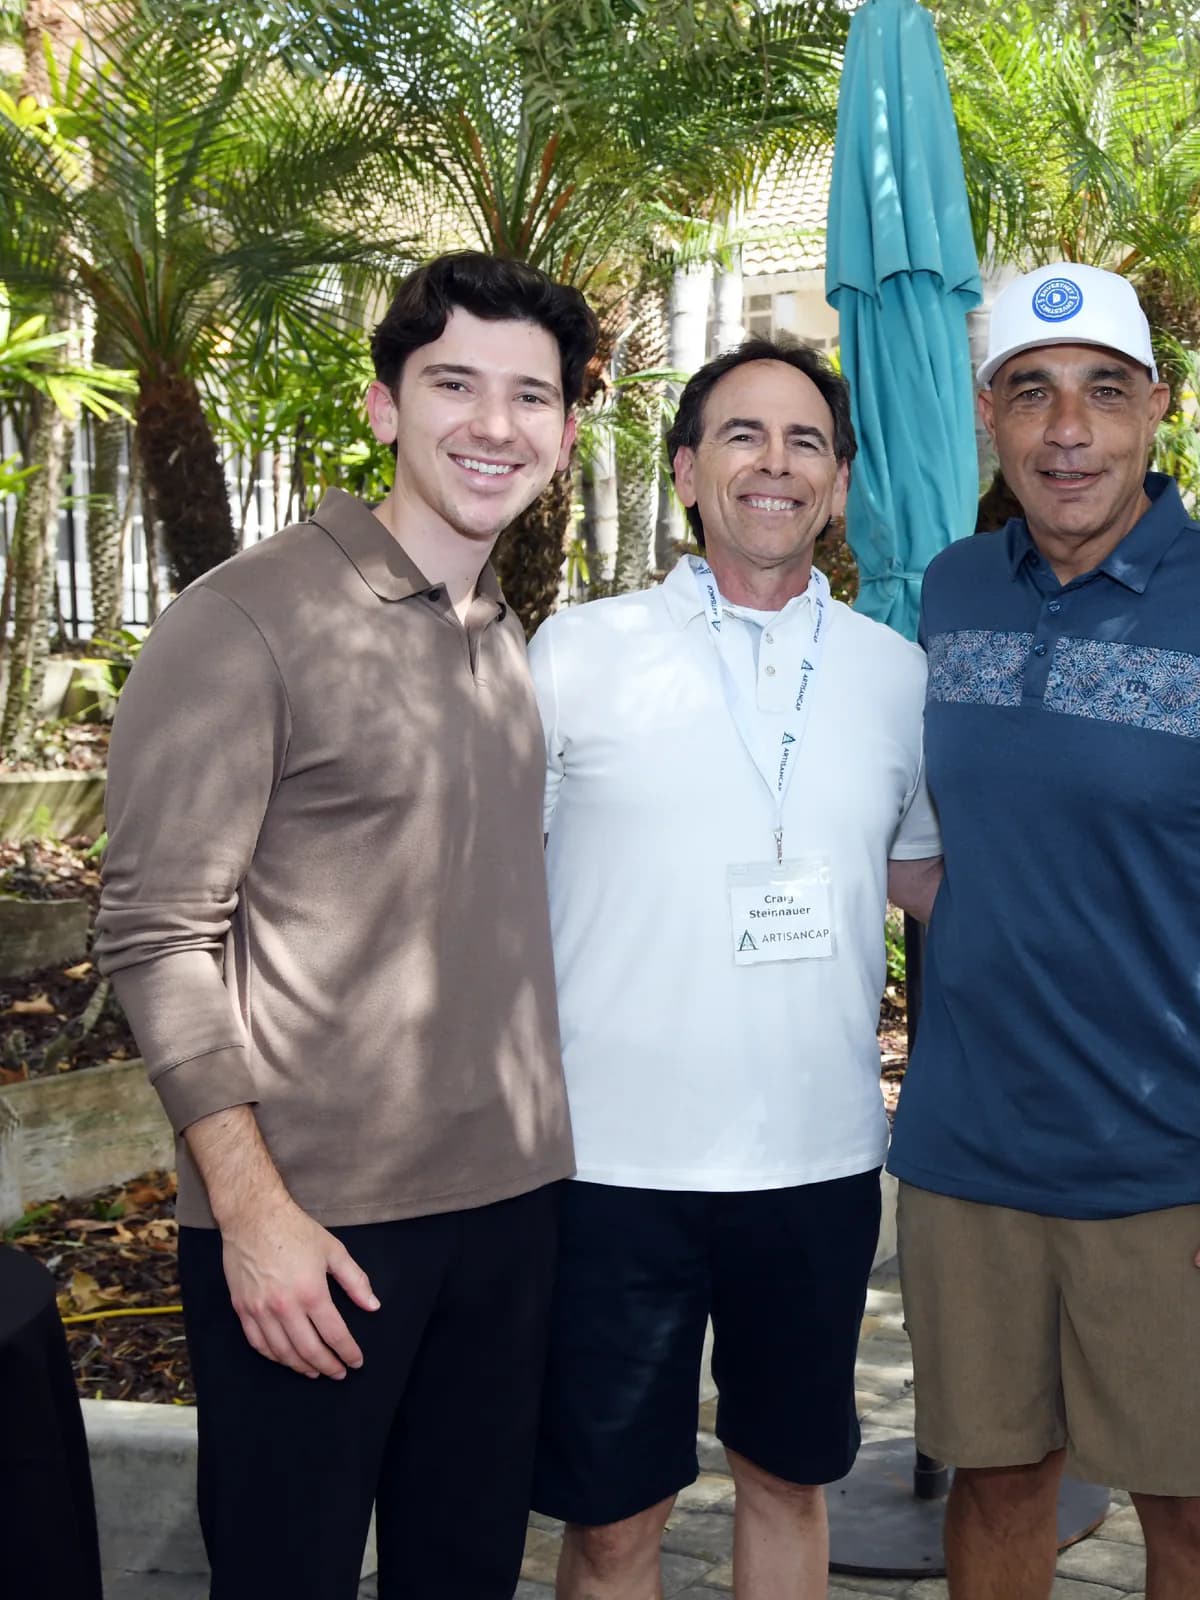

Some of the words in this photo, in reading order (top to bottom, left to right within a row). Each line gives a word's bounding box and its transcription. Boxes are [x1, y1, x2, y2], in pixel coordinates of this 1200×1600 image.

[796, 673, 808, 711] ARTISANCAP
[778, 747, 790, 791] ARTISANCAP
[762, 929, 829, 943] ARTISANCAP
